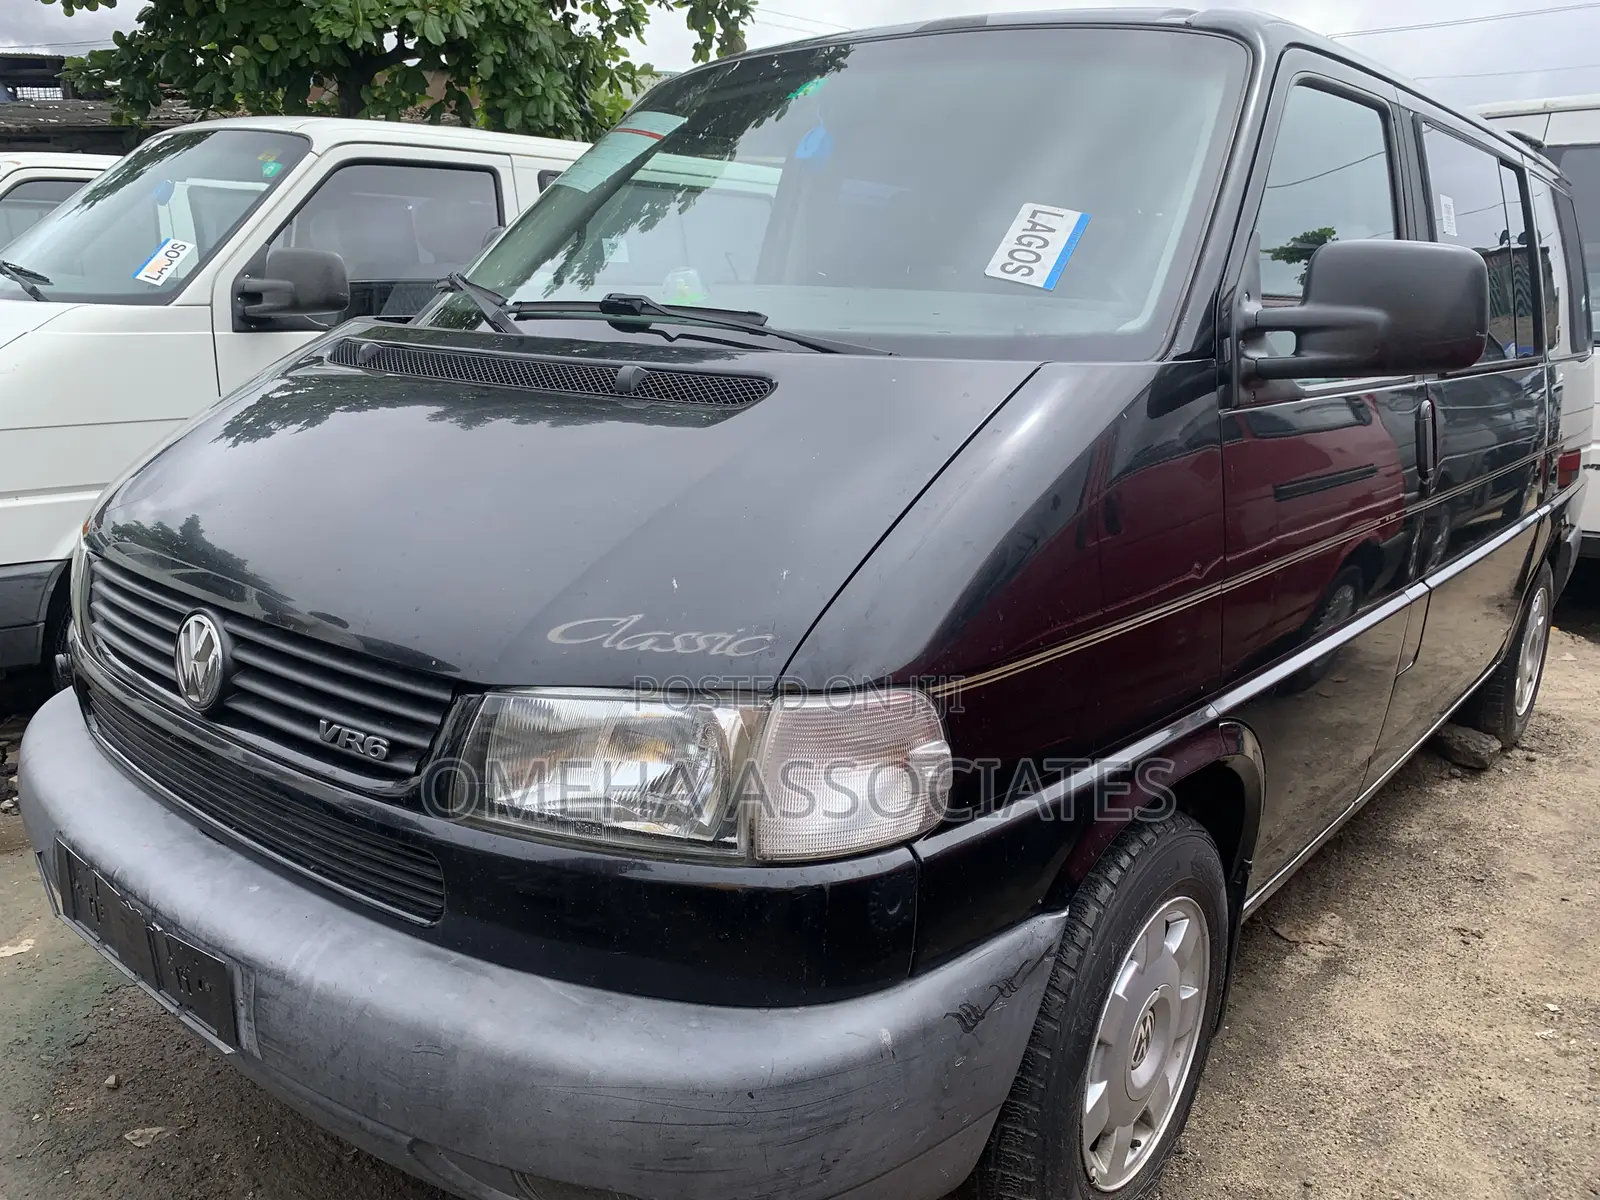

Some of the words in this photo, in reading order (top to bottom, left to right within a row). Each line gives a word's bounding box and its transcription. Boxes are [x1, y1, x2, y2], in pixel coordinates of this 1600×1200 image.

[1000, 209, 1065, 277] LAGOS
[547, 613, 775, 657] Classic
[319, 718, 391, 761] VR6
